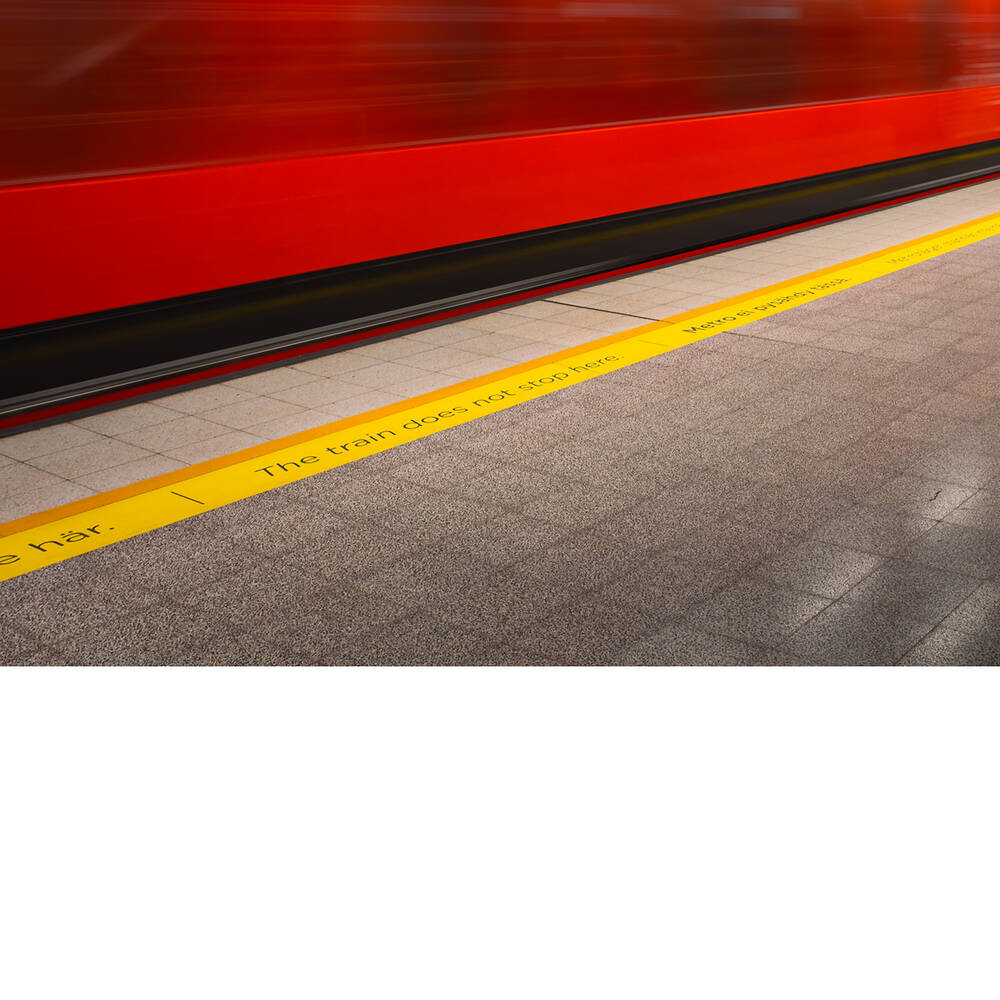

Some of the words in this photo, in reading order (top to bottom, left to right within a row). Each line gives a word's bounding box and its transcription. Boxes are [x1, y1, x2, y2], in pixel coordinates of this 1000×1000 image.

[254, 454, 321, 477] The
[325, 429, 397, 456] train
[402, 406, 468, 430] does
[472, 389, 517, 407] not
[518, 372, 569, 392] stop
[568, 354, 625, 373] here.
[28, 524, 115, 552] här.
